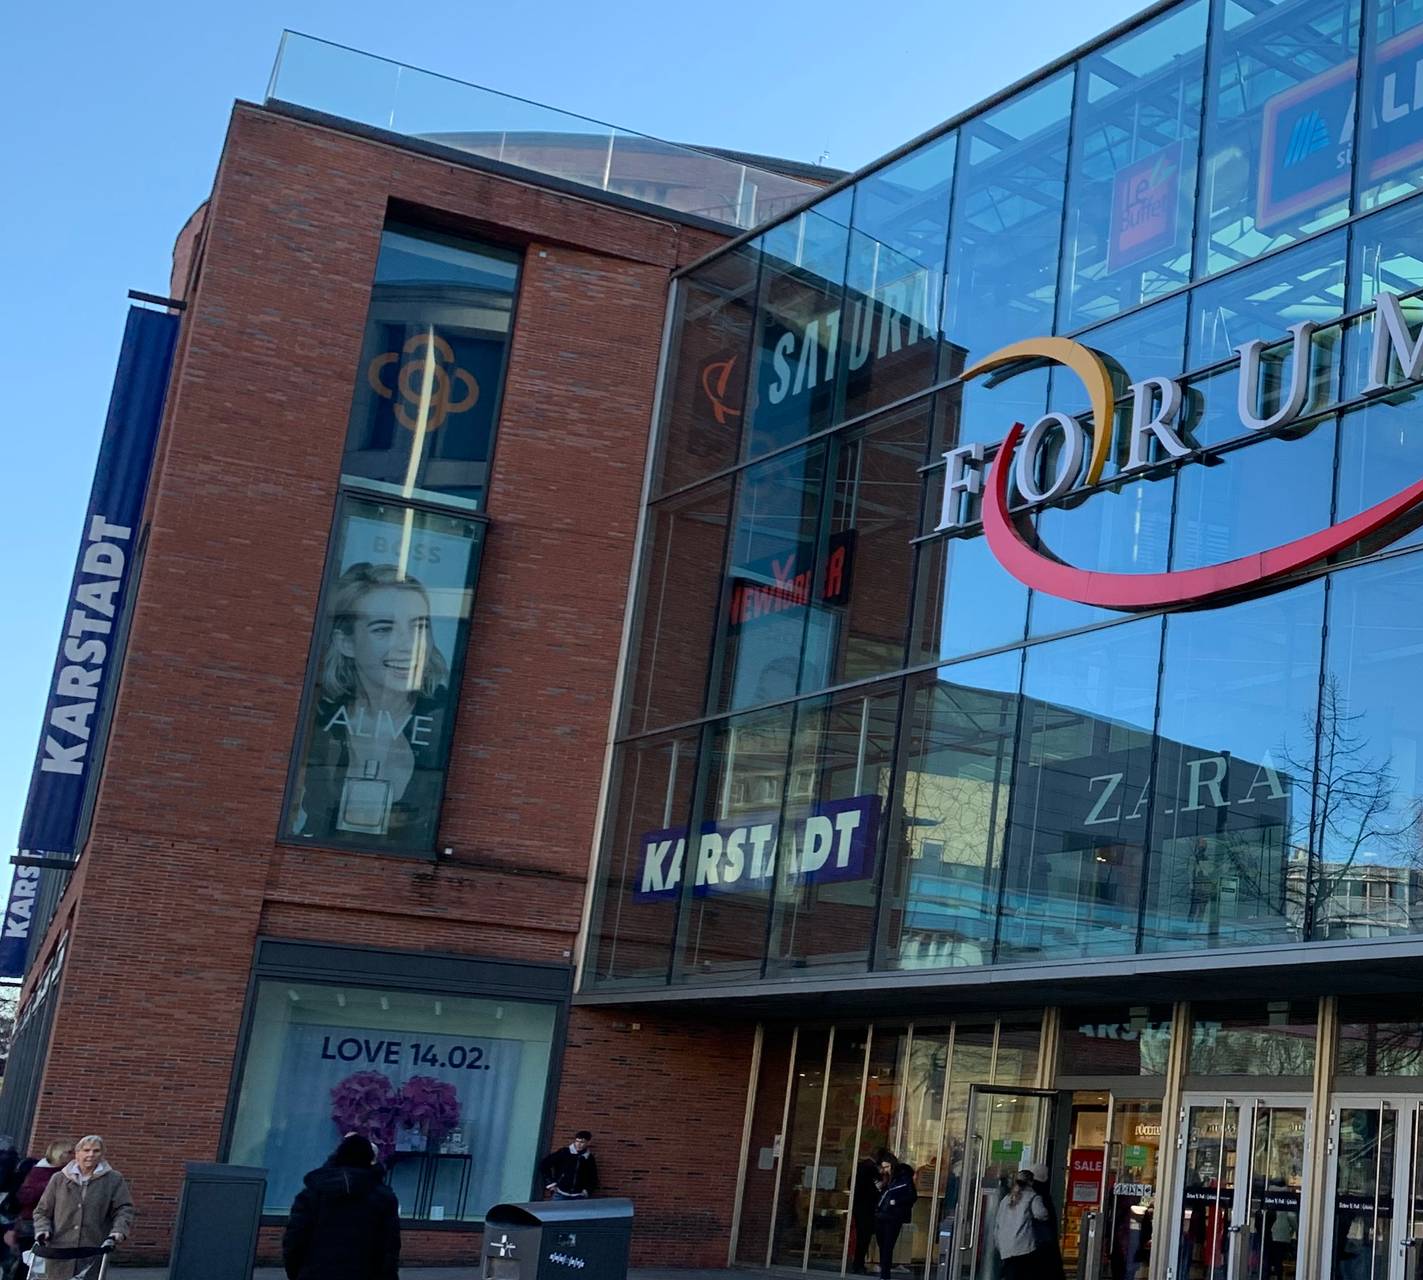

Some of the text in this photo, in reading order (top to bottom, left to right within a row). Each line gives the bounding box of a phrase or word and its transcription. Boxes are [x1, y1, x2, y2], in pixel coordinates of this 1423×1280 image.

[41, 514, 132, 776] KARSTADT
[323, 705, 434, 746] ALIVE
[641, 810, 861, 893] KARSTADT
[321, 1036, 491, 1071] LOVE 14.02.
[1073, 1160, 1102, 1171] SALE
